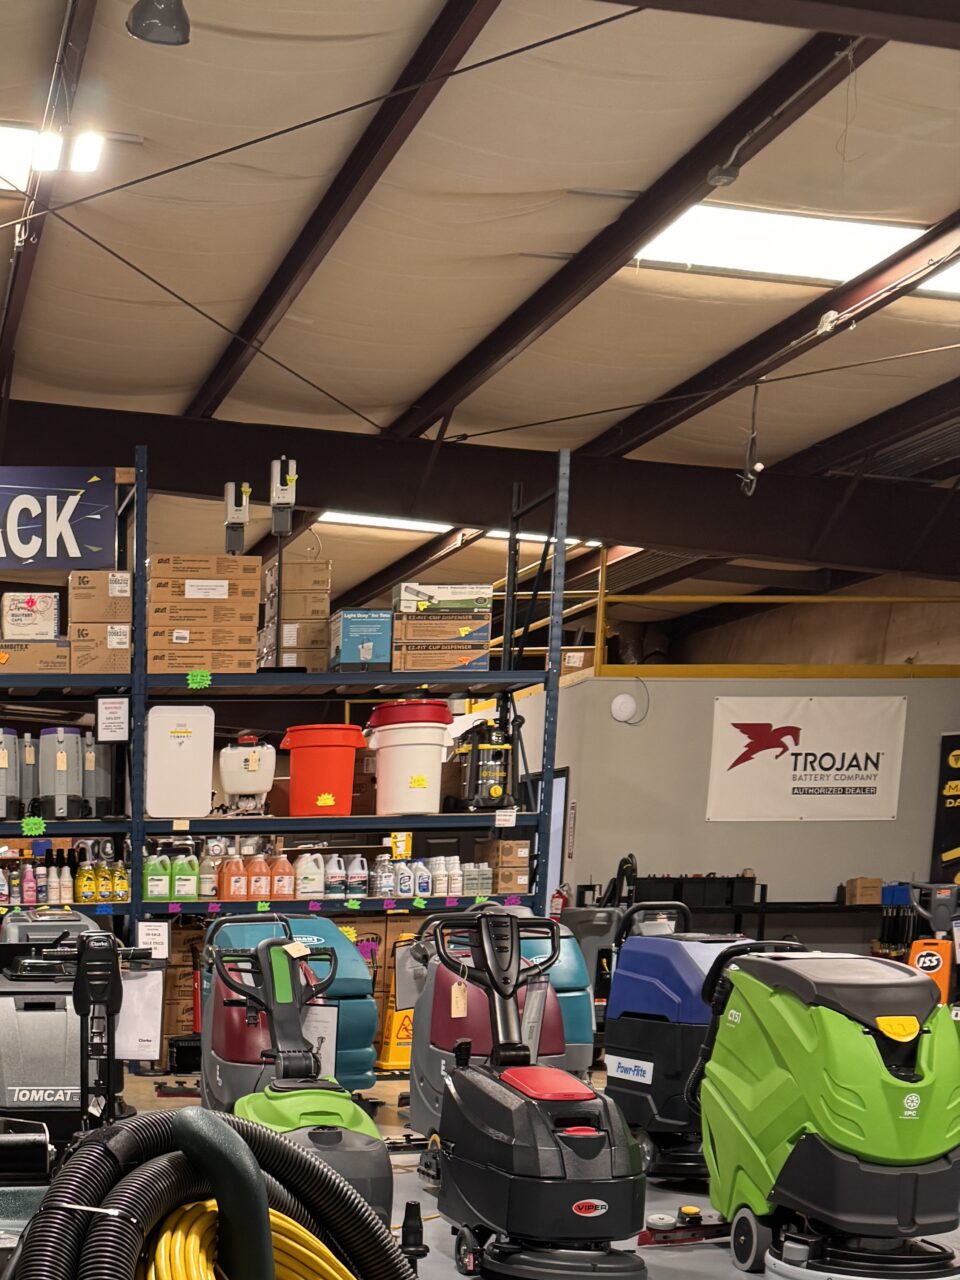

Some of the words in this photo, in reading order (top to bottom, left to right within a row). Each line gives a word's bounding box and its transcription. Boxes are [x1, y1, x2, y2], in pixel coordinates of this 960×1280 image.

[790, 752, 880, 772] TROJAN
[90, 940, 108, 948] Clarke
[918, 955, 938, 968] ISS
[617, 1062, 646, 1078] Powr-Flite
[8, 1086, 80, 1102] TOMCAT
[576, 1204, 608, 1212] VIPER
